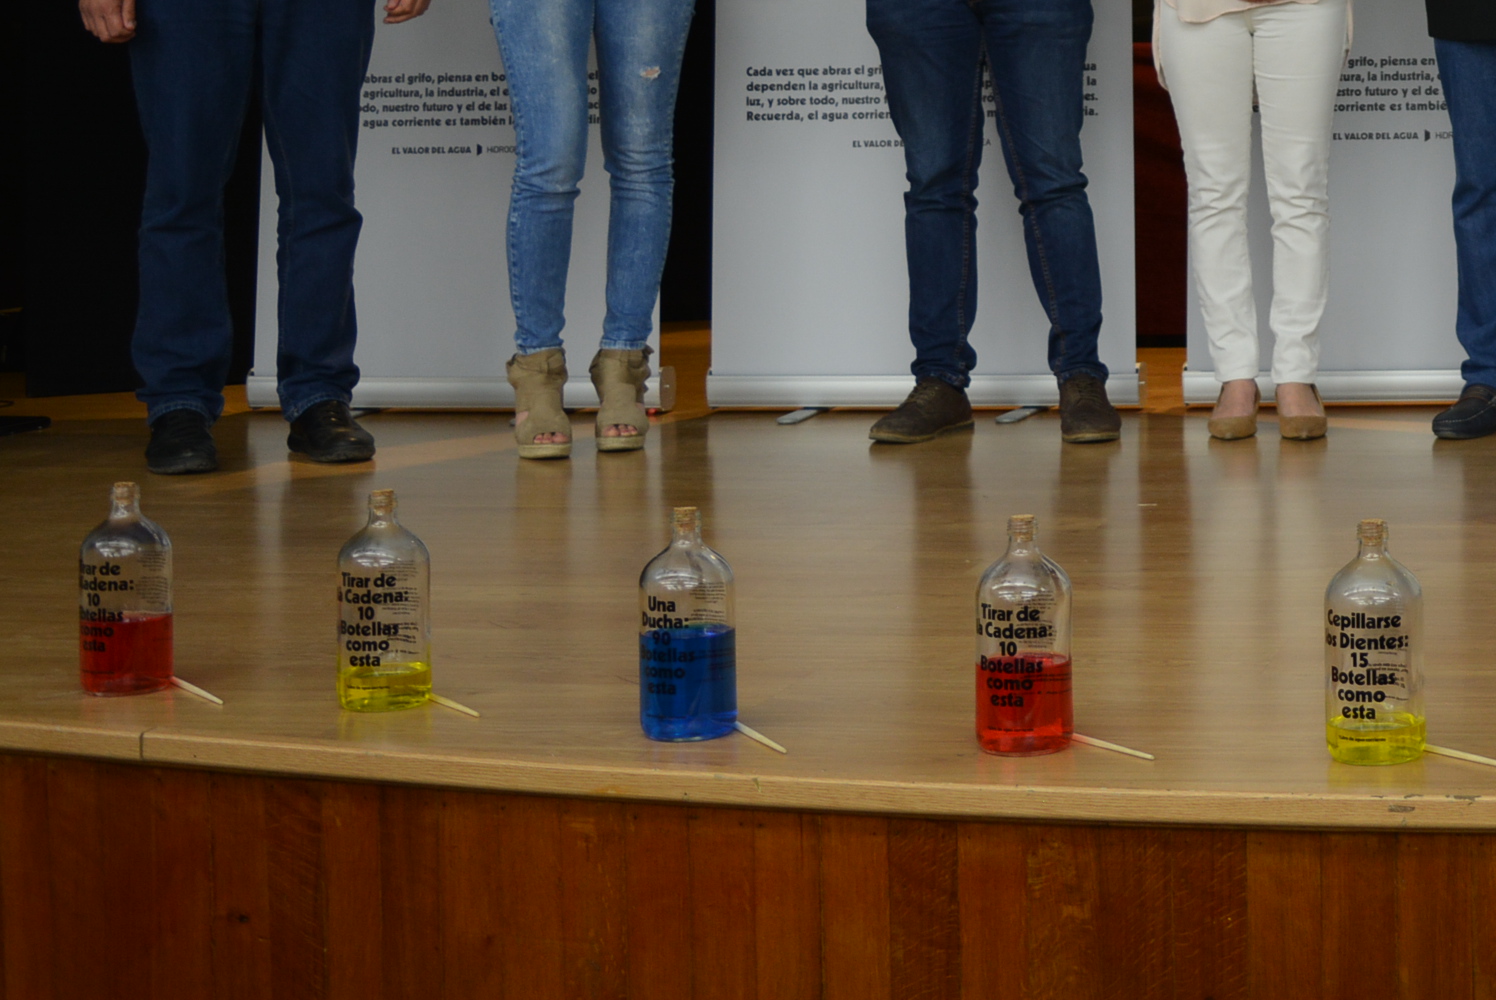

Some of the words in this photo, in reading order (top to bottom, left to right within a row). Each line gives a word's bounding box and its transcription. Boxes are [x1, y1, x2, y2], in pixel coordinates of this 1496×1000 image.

[1348, 57, 1377, 68] grifo,
[1380, 56, 1417, 68] piensa
[1421, 58, 1435, 66] en
[747, 66, 772, 77] Cada
[776, 68, 794, 76] vez
[797, 68, 819, 78] que
[822, 66, 851, 75] abras
[854, 65, 864, 75] el
[1368, 72, 1377, 81] la
[1381, 71, 1434, 82] industria,
[395, 73, 405, 83] el
[408, 73, 435, 85] grifo,
[437, 73, 472, 84] piensa
[475, 73, 489, 82] en
[363, 88, 422, 100] agricultura,
[425, 88, 434, 97] la
[437, 87, 487, 97] industria,
[490, 87, 500, 96] el
[747, 81, 805, 93] dependen
[809, 81, 818, 90] la
[821, 80, 883, 92] agricultura,
[1365, 86, 1398, 96] futuro
[1402, 88, 1408, 98] y
[1412, 86, 1421, 95] el
[1425, 86, 1439, 95] de
[382, 103, 419, 112] nuestro
[422, 102, 453, 112] futuro
[466, 102, 474, 111] el
[478, 101, 491, 111] de
[494, 101, 507, 110] las
[746, 96, 764, 107] luz,
[767, 98, 774, 107] y
[777, 96, 807, 106] sobre
[810, 96, 838, 107] todo,
[842, 95, 880, 104] nuestro
[363, 119, 388, 129] agua
[392, 117, 441, 127] corriente
[445, 118, 456, 126] es
[460, 116, 505, 126] también
[747, 111, 803, 122] Recuerda,
[808, 110, 818, 120] el
[822, 111, 848, 122] agua
[1344, 132, 1373, 140] VALOR
[1376, 132, 1391, 140] DEL
[1393, 132, 1418, 140] AGUA
[432, 146, 445, 154] DEL
[853, 140, 861, 148] EL
[100, 562, 120, 576] de
[342, 572, 370, 588] Tirar
[374, 573, 396, 587] de
[87, 593, 100, 607] 10
[345, 589, 409, 605] Cadena:
[648, 596, 676, 612] Una
[358, 606, 374, 620] 10
[981, 603, 1013, 621] Tirar
[1016, 606, 1040, 622] de
[642, 611, 689, 629] Ducha:
[1328, 609, 1401, 631] Cepillarse
[340, 620, 399, 636] Botellas
[985, 622, 1052, 639] Cadena:
[652, 631, 671, 645] 90
[1340, 632, 1409, 650] Dientes:
[346, 640, 390, 651] como
[999, 641, 1017, 656] 10
[350, 655, 380, 667] esta
[980, 655, 1043, 674] Botellas
[1351, 652, 1368, 668] 15
[644, 665, 686, 679] como
[1332, 666, 1396, 685] Botellas
[647, 681, 676, 695] esta
[987, 677, 1033, 690] como
[990, 694, 1024, 707] esta
[1338, 689, 1386, 703] como
[1342, 706, 1376, 720] esta
